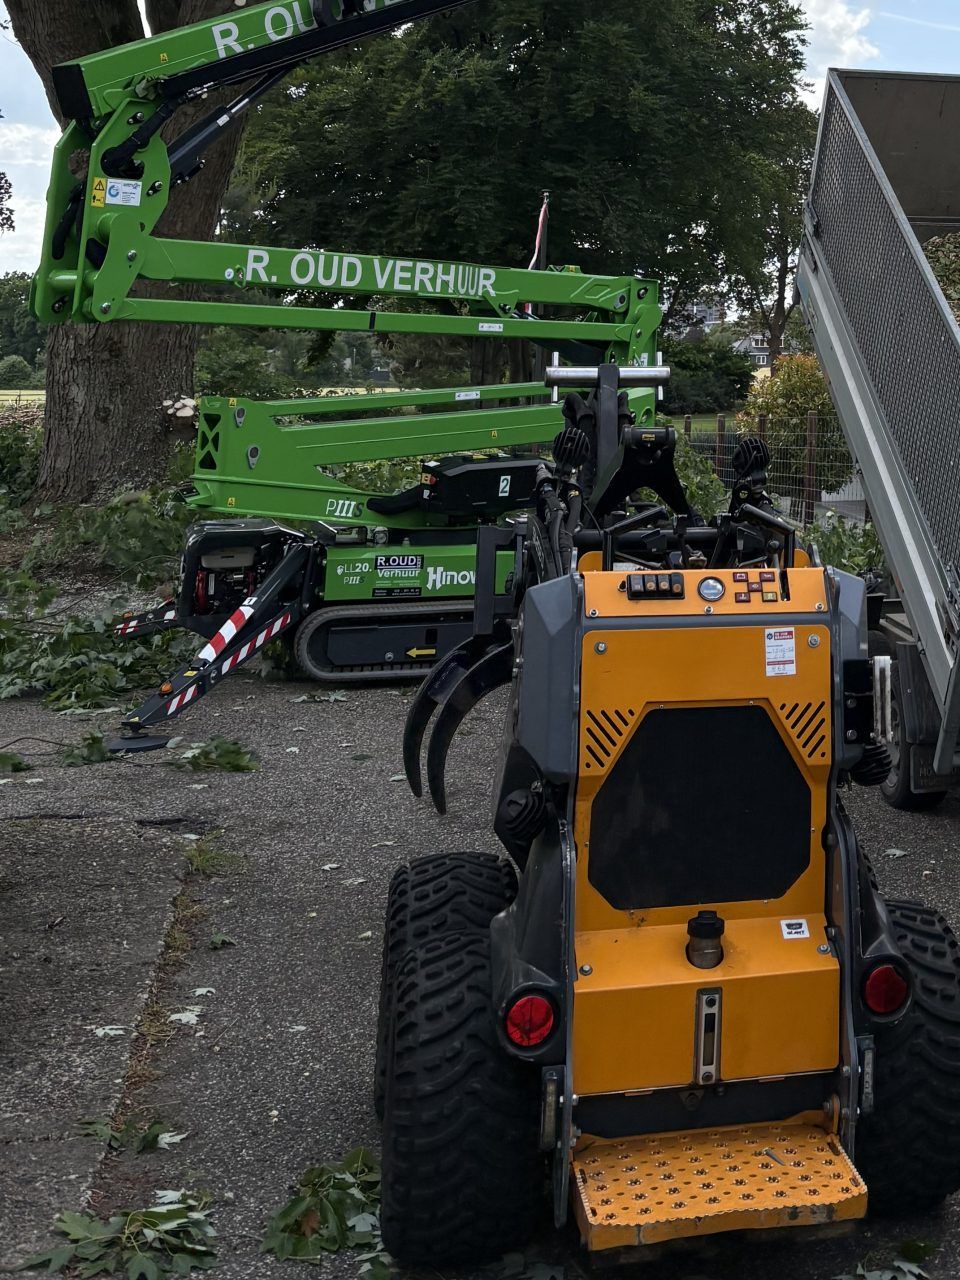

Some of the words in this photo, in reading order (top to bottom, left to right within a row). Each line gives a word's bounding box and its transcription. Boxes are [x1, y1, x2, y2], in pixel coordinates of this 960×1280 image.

[211, 21, 255, 59] R.
[245, 249, 278, 283] R.
[290, 253, 363, 288] OUD
[373, 258, 496, 297] VERHUUR
[500, 477, 510, 495] 2
[377, 568, 421, 578] Verhuur
